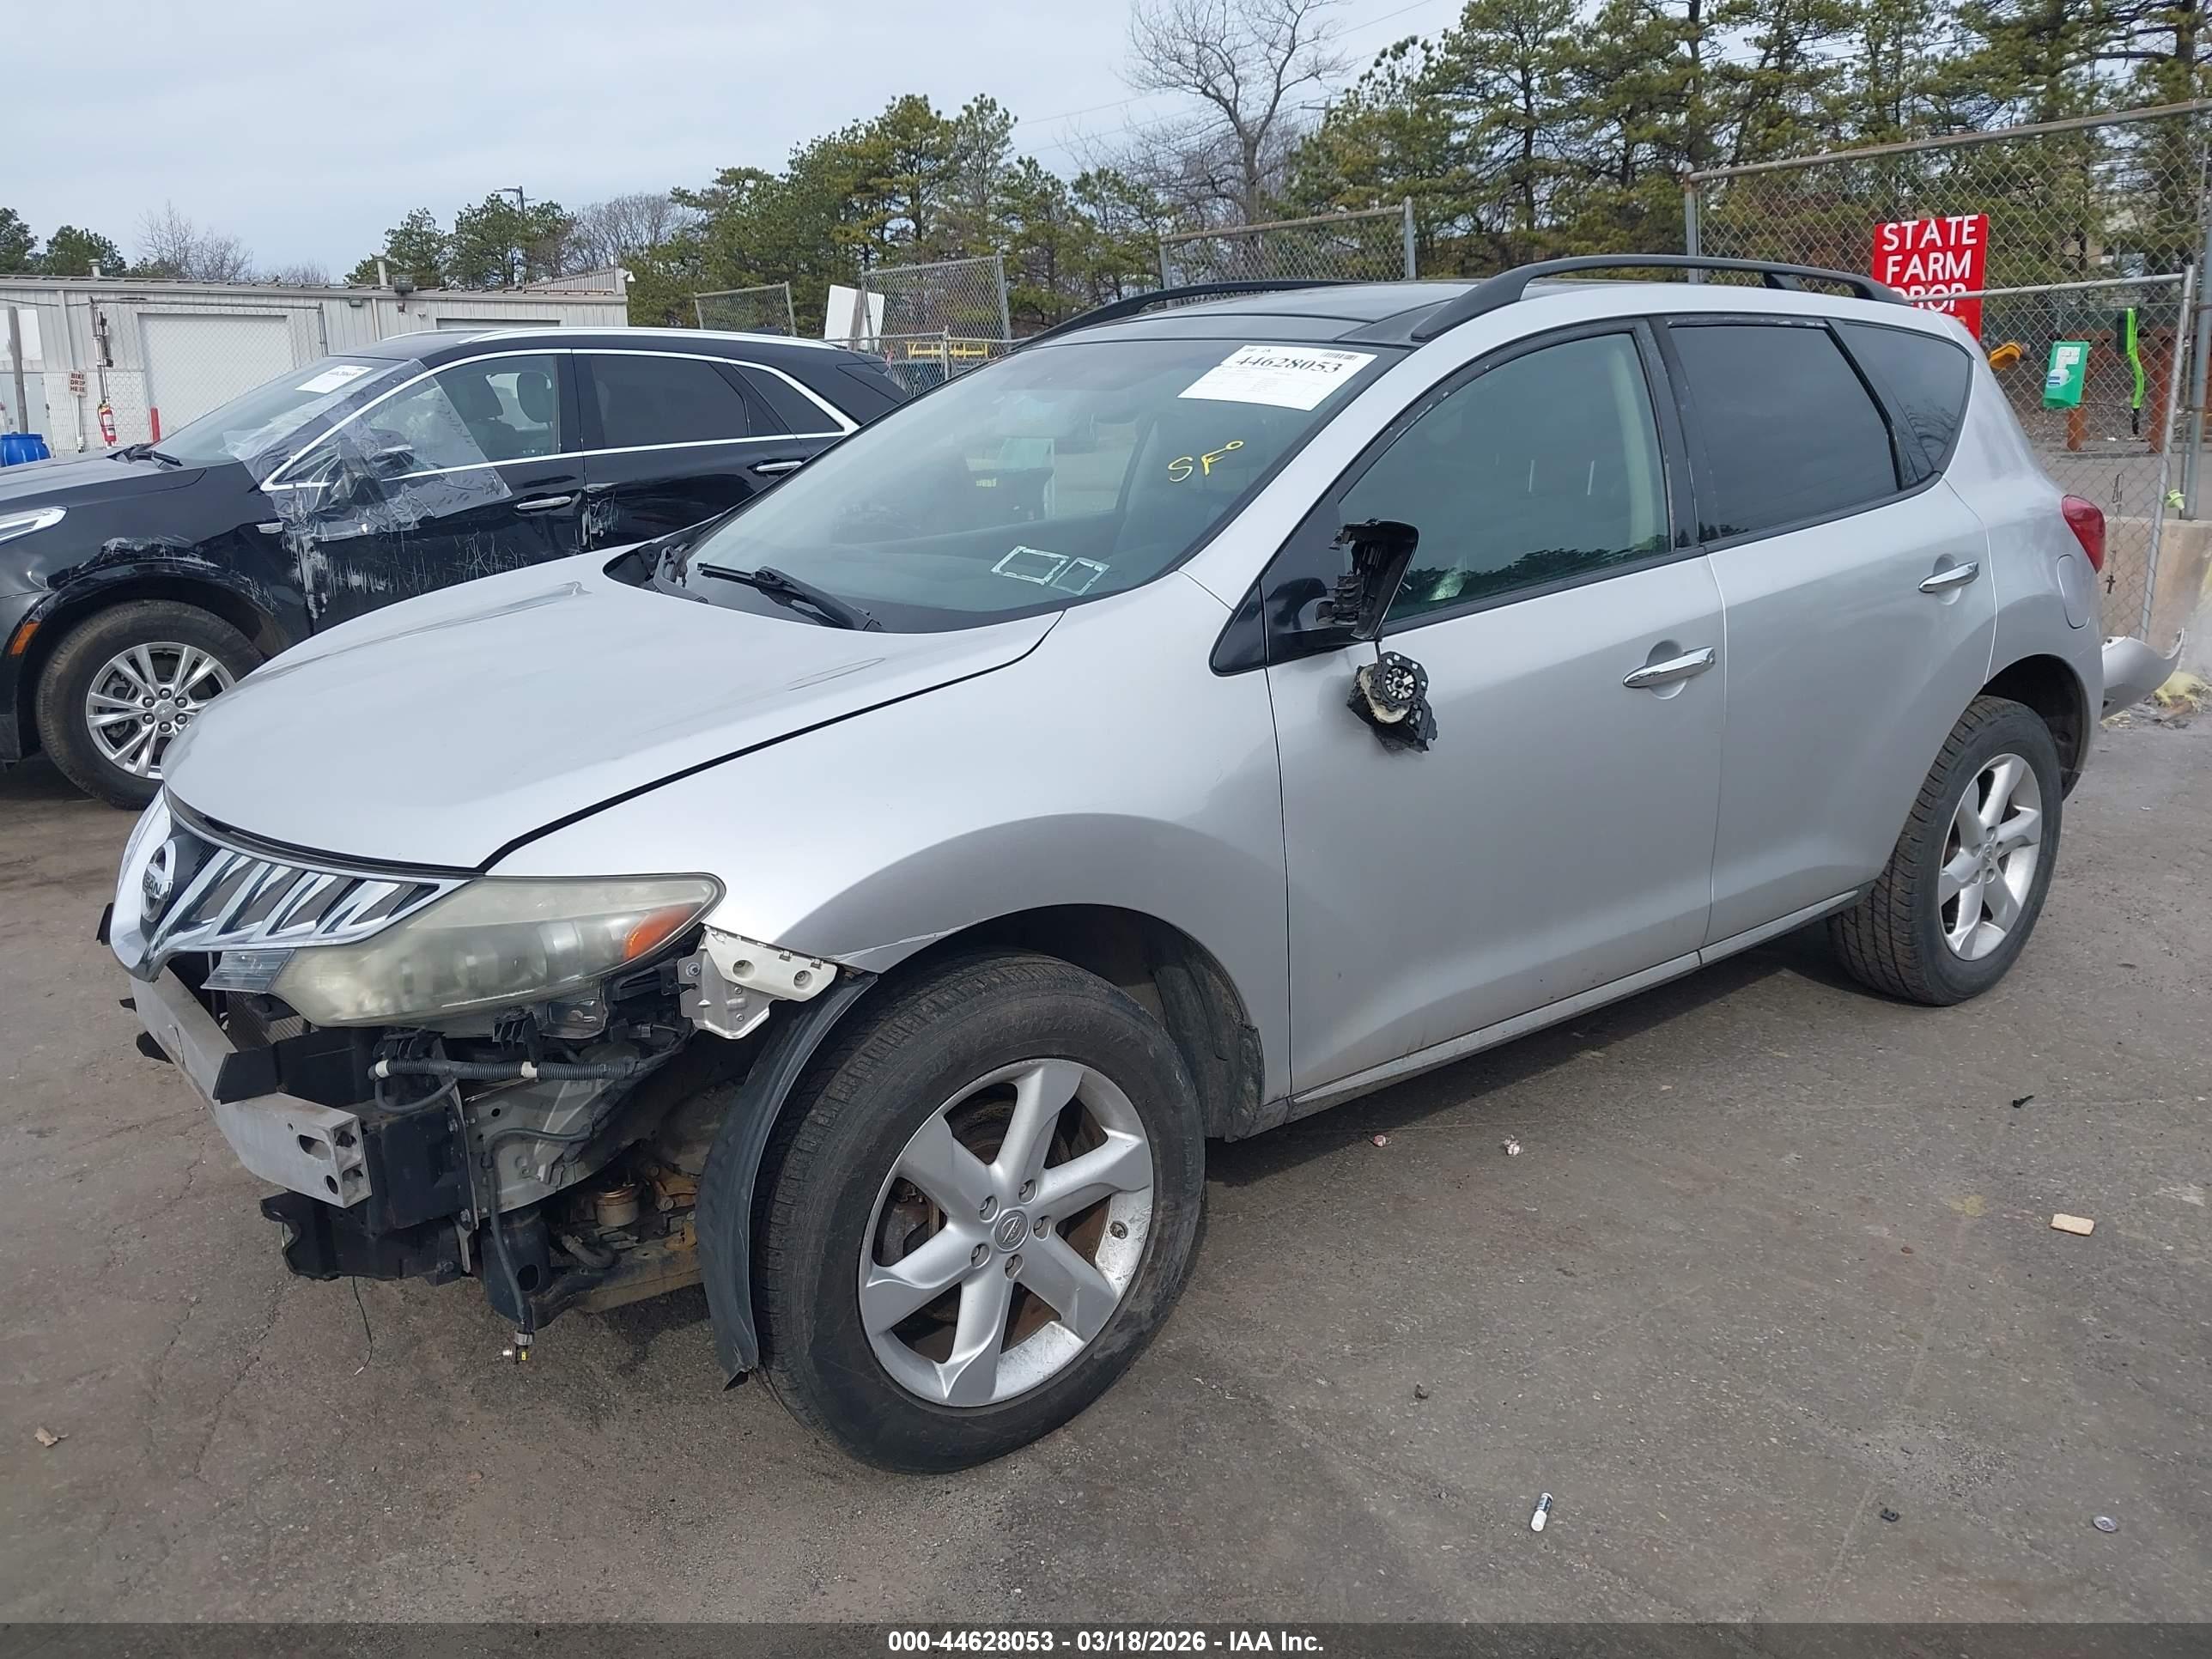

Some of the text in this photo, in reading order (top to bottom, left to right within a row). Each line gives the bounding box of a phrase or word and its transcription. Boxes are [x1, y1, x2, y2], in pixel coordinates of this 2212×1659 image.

[1882, 215, 1978, 251] STATE
[1887, 250, 1972, 284] FARM
[1236, 356, 1342, 373] 44628053
